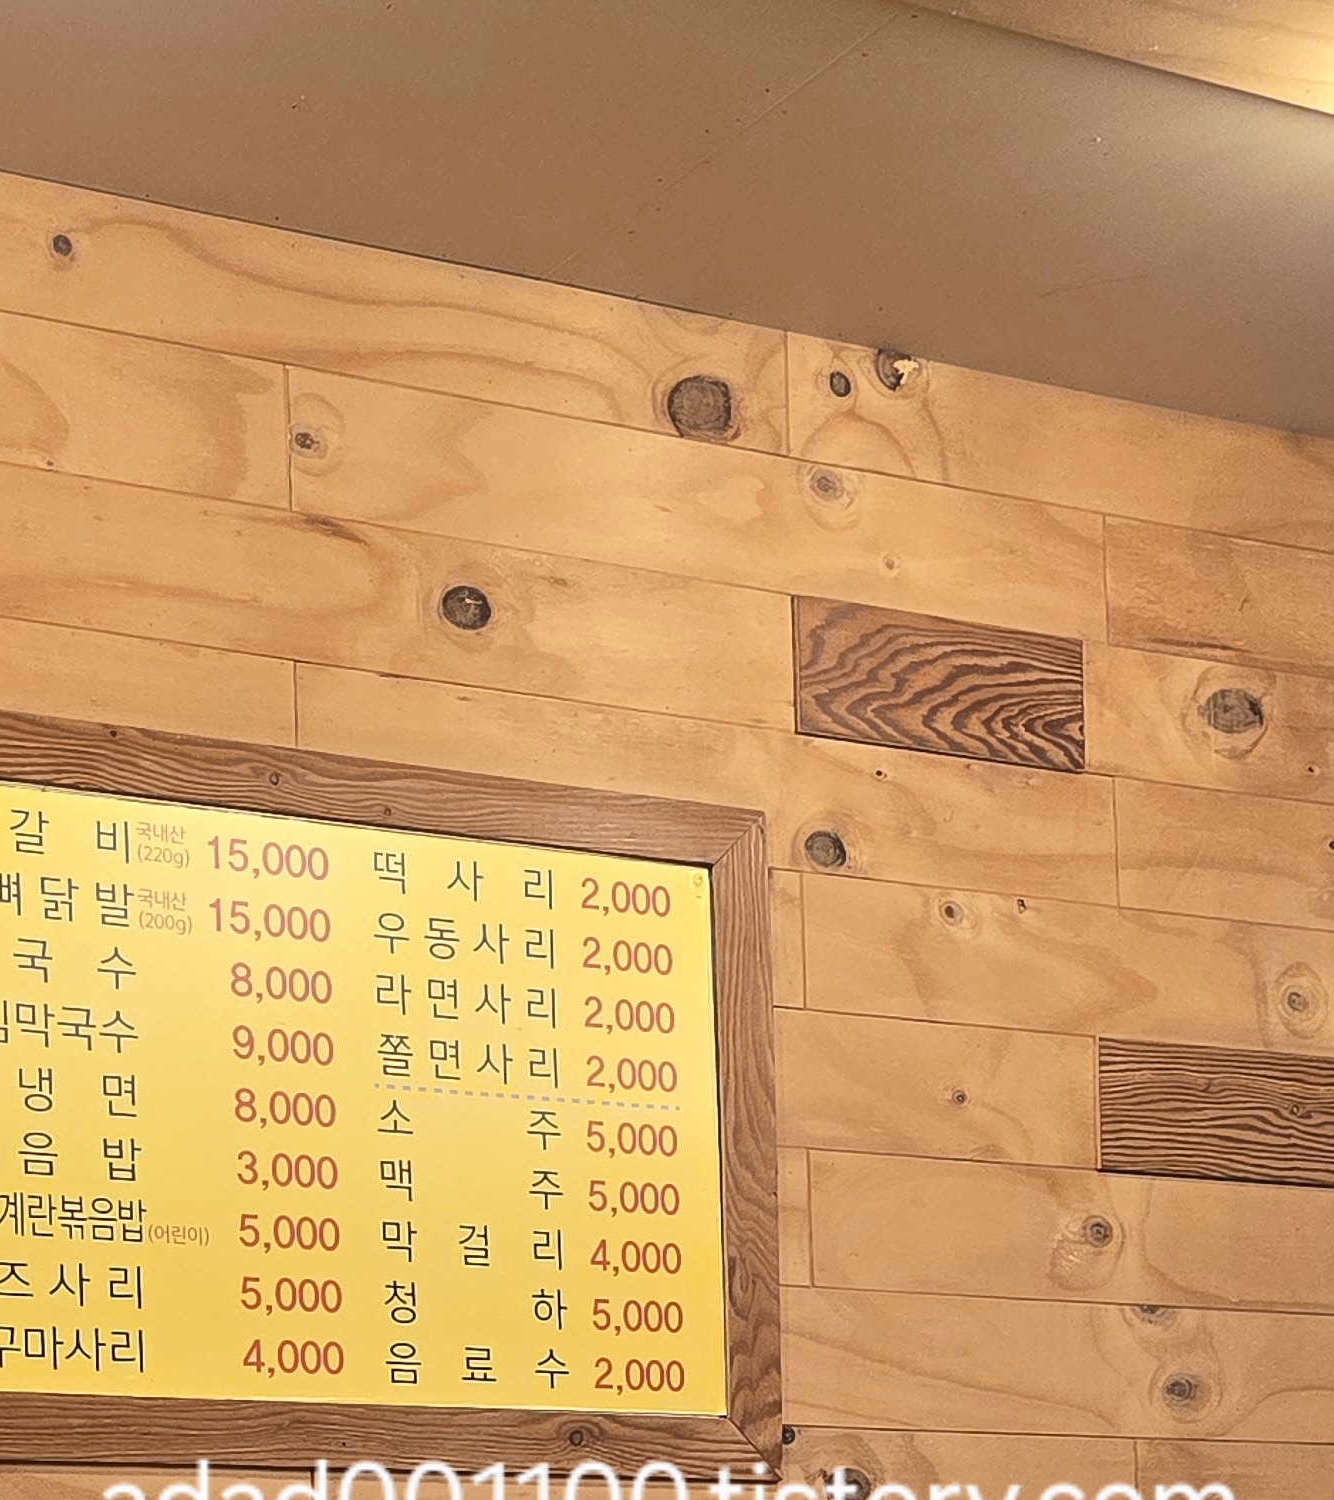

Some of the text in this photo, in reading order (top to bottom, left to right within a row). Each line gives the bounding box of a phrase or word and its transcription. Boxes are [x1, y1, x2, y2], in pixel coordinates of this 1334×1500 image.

[136, 822, 185, 844] 국내산
[138, 844, 189, 868] (220g)
[208, 836, 329, 880] 15,000
[137, 889, 187, 911] 국내산
[582, 877, 670, 917] 2,000
[139, 911, 192, 935] (200g)
[209, 898, 330, 942] 15,000
[583, 937, 673, 975] 2,000
[231, 962, 332, 1004] 8,000
[585, 996, 675, 1035] 2,000
[233, 1025, 333, 1066] 9,000
[586, 1055, 677, 1093] 2,000
[235, 1088, 336, 1129] 8,000
[587, 1120, 677, 1158] 5,000
[237, 1150, 338, 1191] 3,000
[589, 1180, 680, 1217] 5,000
[148, 1224, 209, 1246] (어린이)
[239, 1214, 340, 1253] 5,000
[590, 1239, 681, 1277] 4,000
[241, 1276, 342, 1316] 5,000
[593, 1299, 683, 1336] 5,000
[243, 1339, 344, 1378] 4,000
[595, 1357, 684, 1395] 2,000
